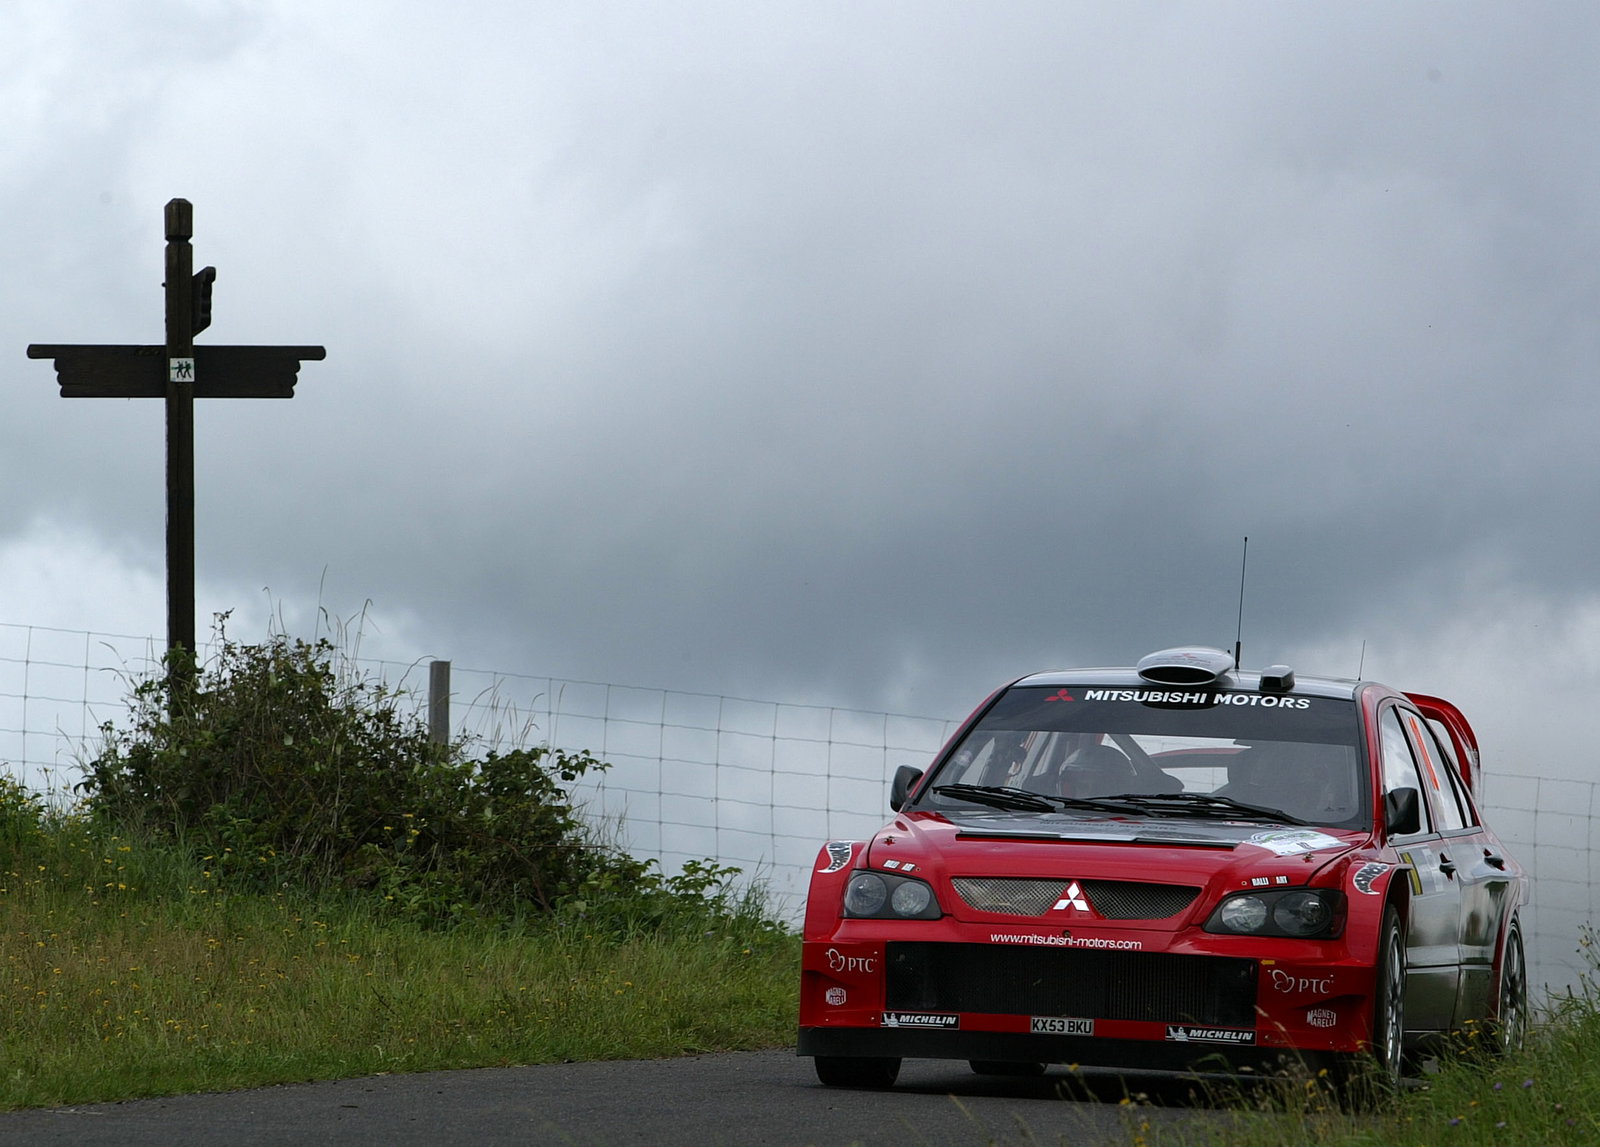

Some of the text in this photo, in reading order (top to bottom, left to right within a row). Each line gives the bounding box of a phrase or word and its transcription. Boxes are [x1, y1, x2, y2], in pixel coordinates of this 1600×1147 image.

[1084, 689, 1311, 710] MITSUBISHI MOTORS
[848, 957, 874, 973] PTC
[1299, 978, 1330, 994] PTC
[899, 1014, 956, 1025] MICHELIN
[1032, 1018, 1092, 1034] KX53 BKU
[1189, 1029, 1253, 1040] MICHELIN
